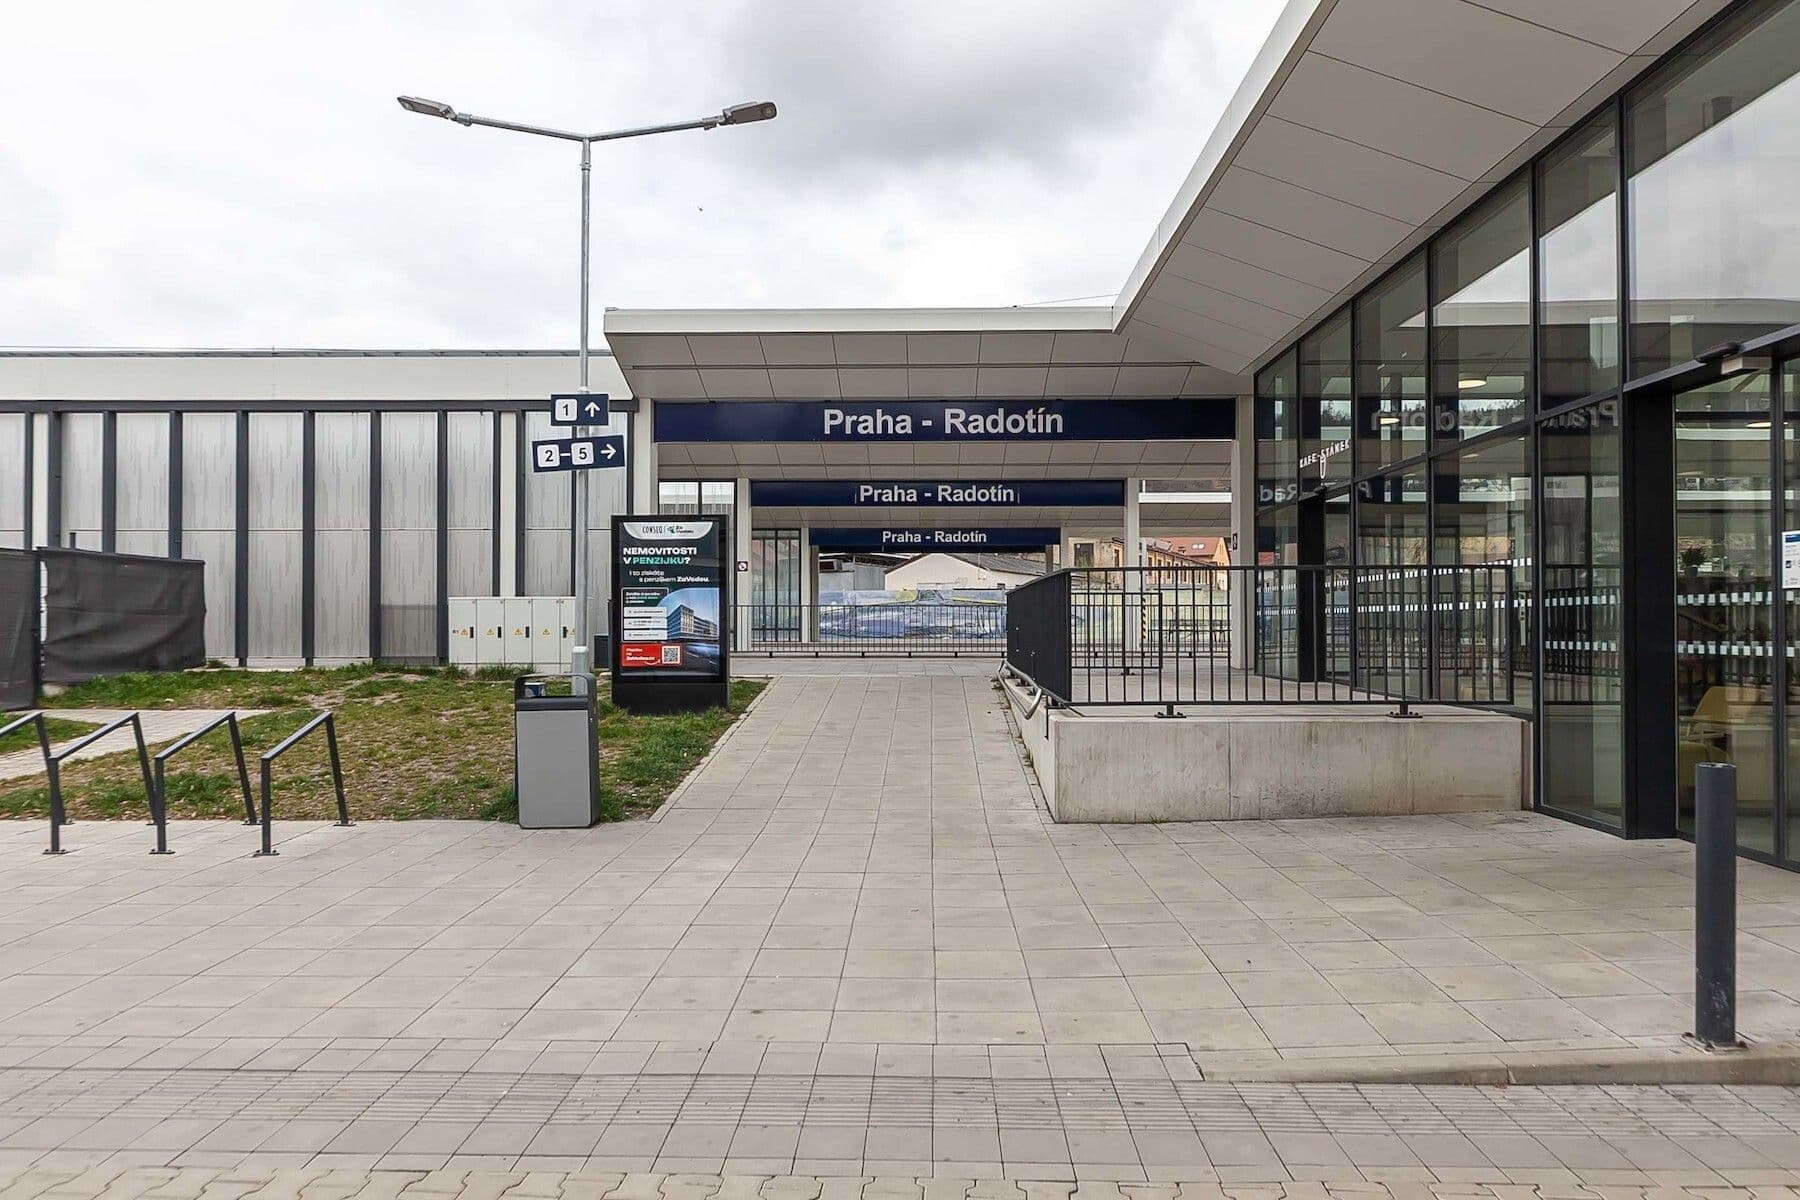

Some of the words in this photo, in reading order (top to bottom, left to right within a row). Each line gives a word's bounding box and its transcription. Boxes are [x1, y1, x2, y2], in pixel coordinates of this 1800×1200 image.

[562, 404, 569, 416] 1
[823, 408, 913, 434] Praha
[944, 407, 1064, 434] Radotín
[859, 485, 918, 502] Praha
[937, 484, 1015, 502] Radotín
[882, 530, 922, 543] Praha
[934, 530, 987, 543] Radotín
[623, 547, 697, 555] NEMOVITOSTI
[623, 557, 631, 565] V
[633, 557, 691, 565] PENZIJKU?
